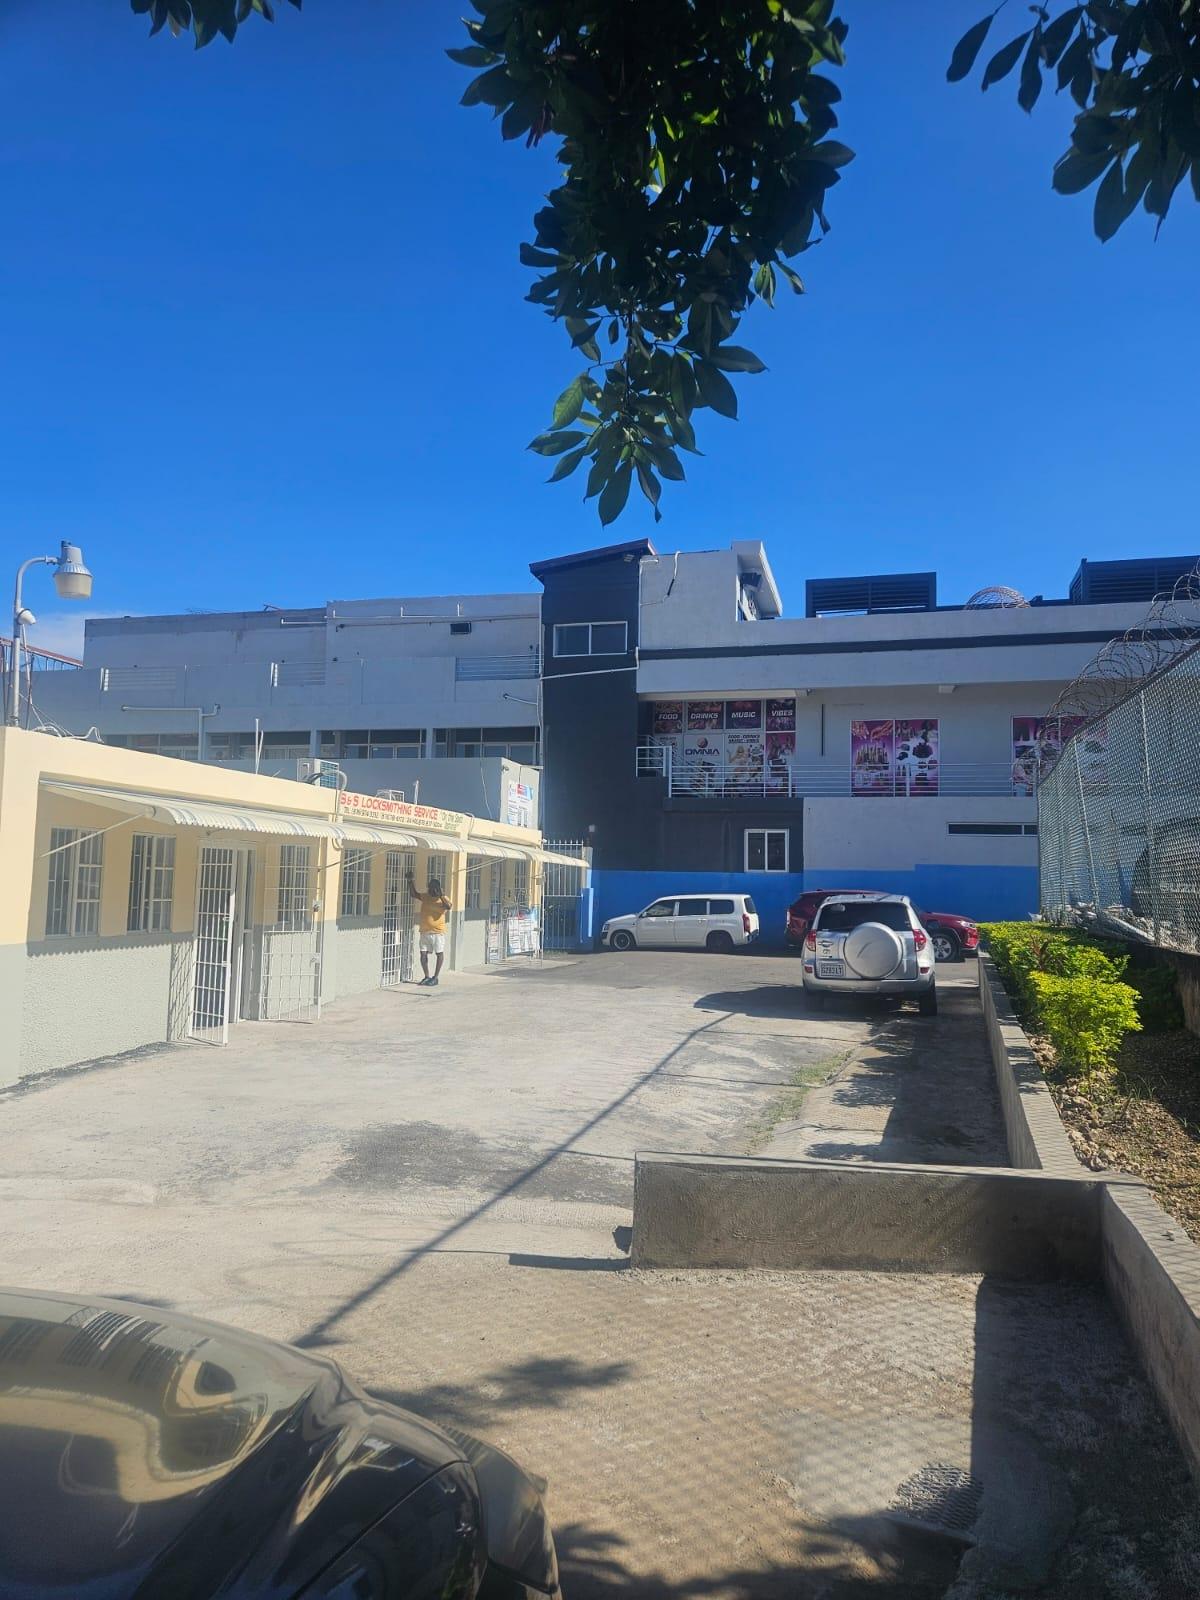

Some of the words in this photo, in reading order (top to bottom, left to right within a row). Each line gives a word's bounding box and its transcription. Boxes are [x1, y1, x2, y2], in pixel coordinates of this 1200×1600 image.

[690, 712, 719, 720] DRINKS
[731, 711, 756, 719] MUSIC
[685, 748, 720, 756] OMNIA
[361, 797, 412, 815] LOCKSMITHING
[414, 806, 438, 820] SERVICE
